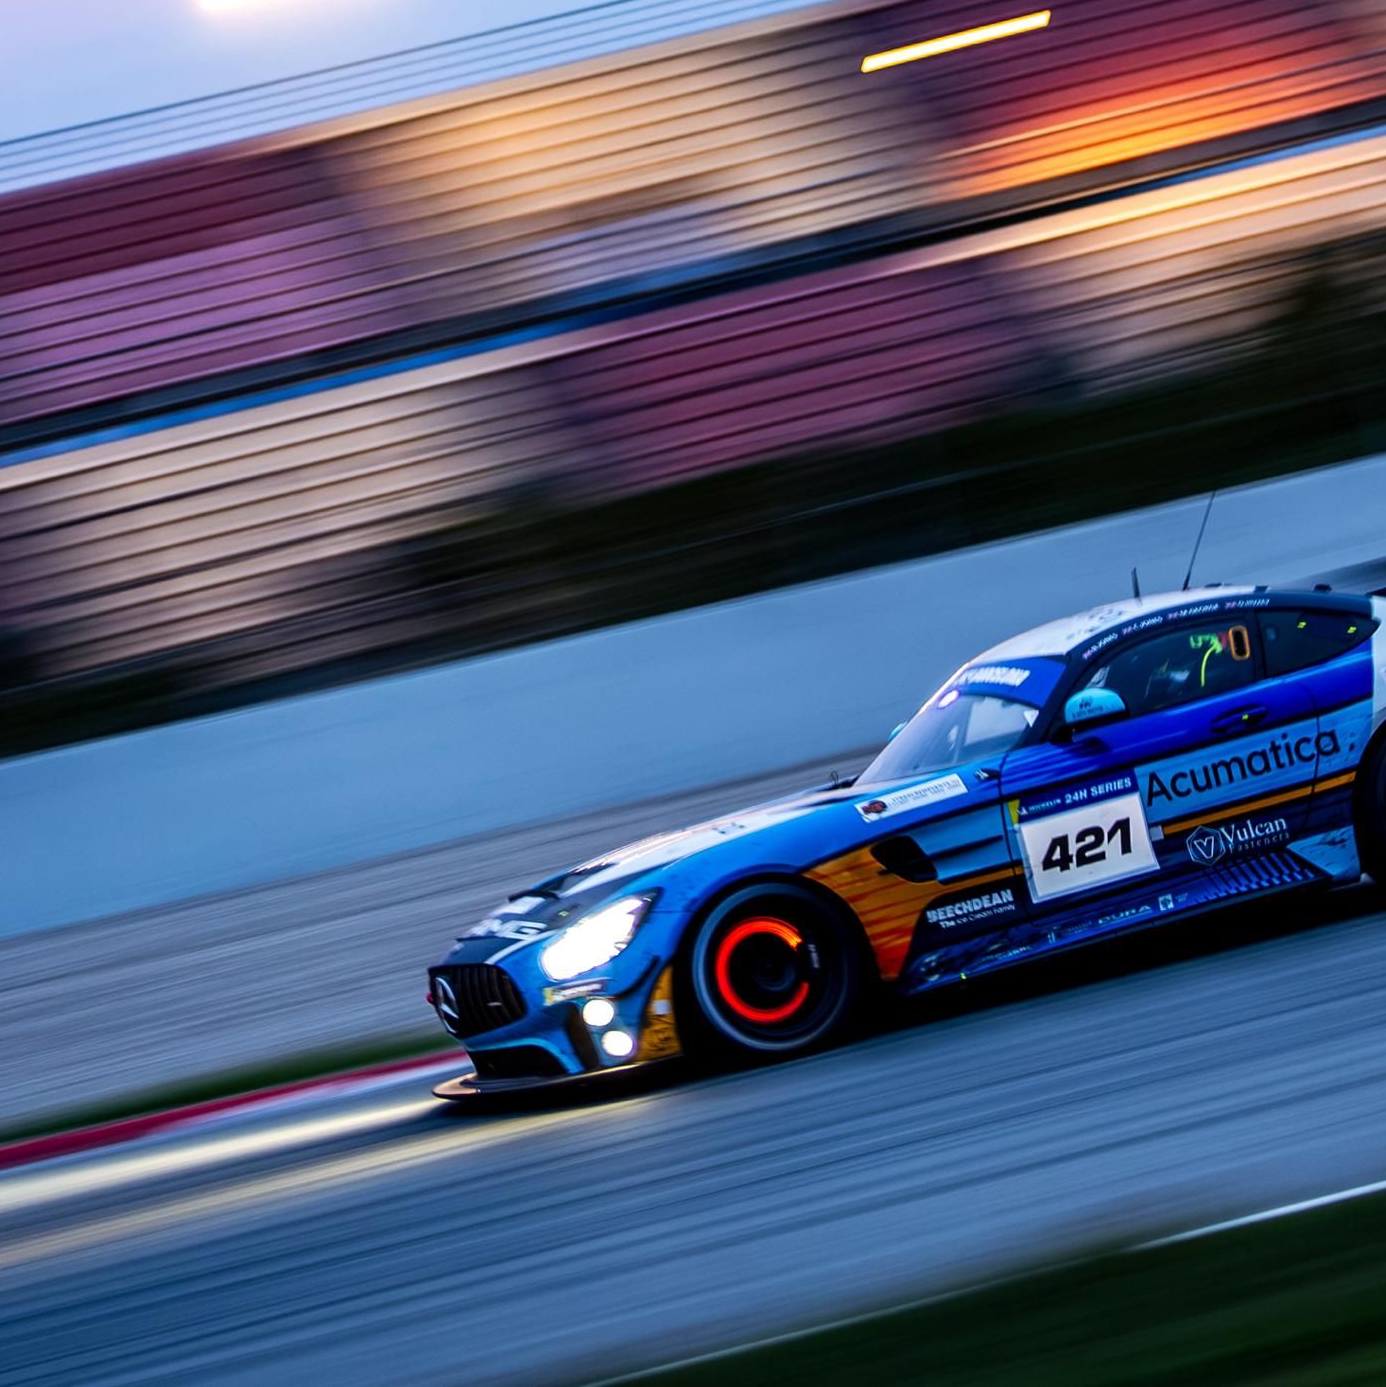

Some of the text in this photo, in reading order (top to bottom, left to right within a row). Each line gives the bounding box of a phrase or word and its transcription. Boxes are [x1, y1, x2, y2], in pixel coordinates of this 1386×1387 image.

[1146, 729, 1341, 806] Acumatica
[1090, 777, 1132, 797] SERIES
[1041, 817, 1133, 872] 421
[1220, 817, 1288, 843] Vulcan
[926, 888, 1014, 924] BEECHDEAN
